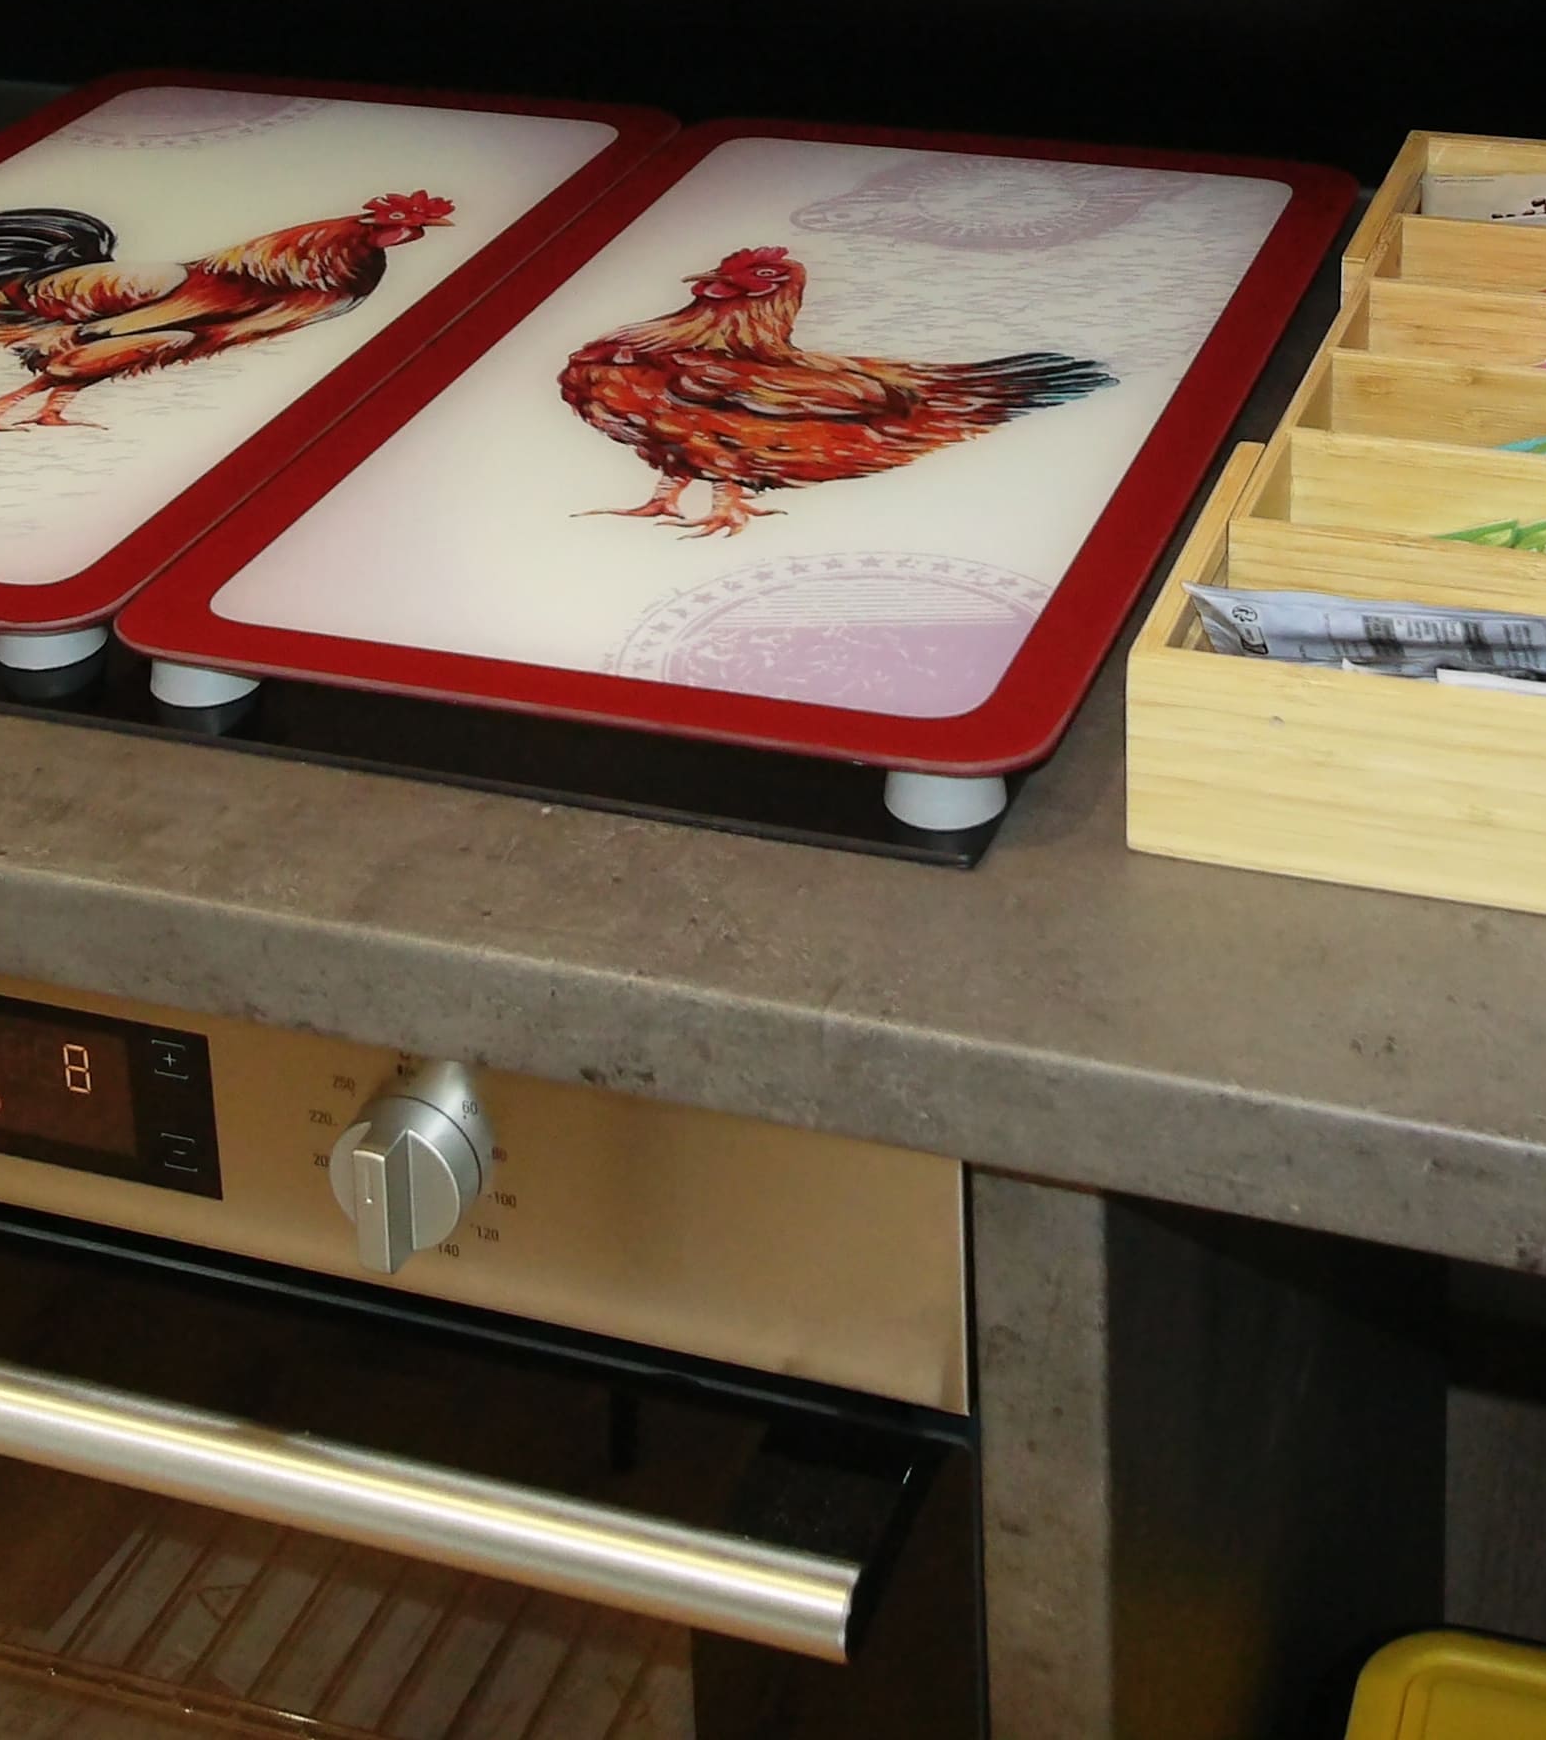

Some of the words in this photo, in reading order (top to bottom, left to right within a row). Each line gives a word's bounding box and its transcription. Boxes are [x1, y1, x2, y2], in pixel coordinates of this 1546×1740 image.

[63, 1044, 92, 1094] 8
[462, 1099, 478, 1115] 60
[310, 1110, 333, 1126] 220
[313, 1153, 330, 1169] 20
[494, 1191, 517, 1208] 100
[476, 1225, 500, 1241] 120
[438, 1243, 460, 1258] 140
